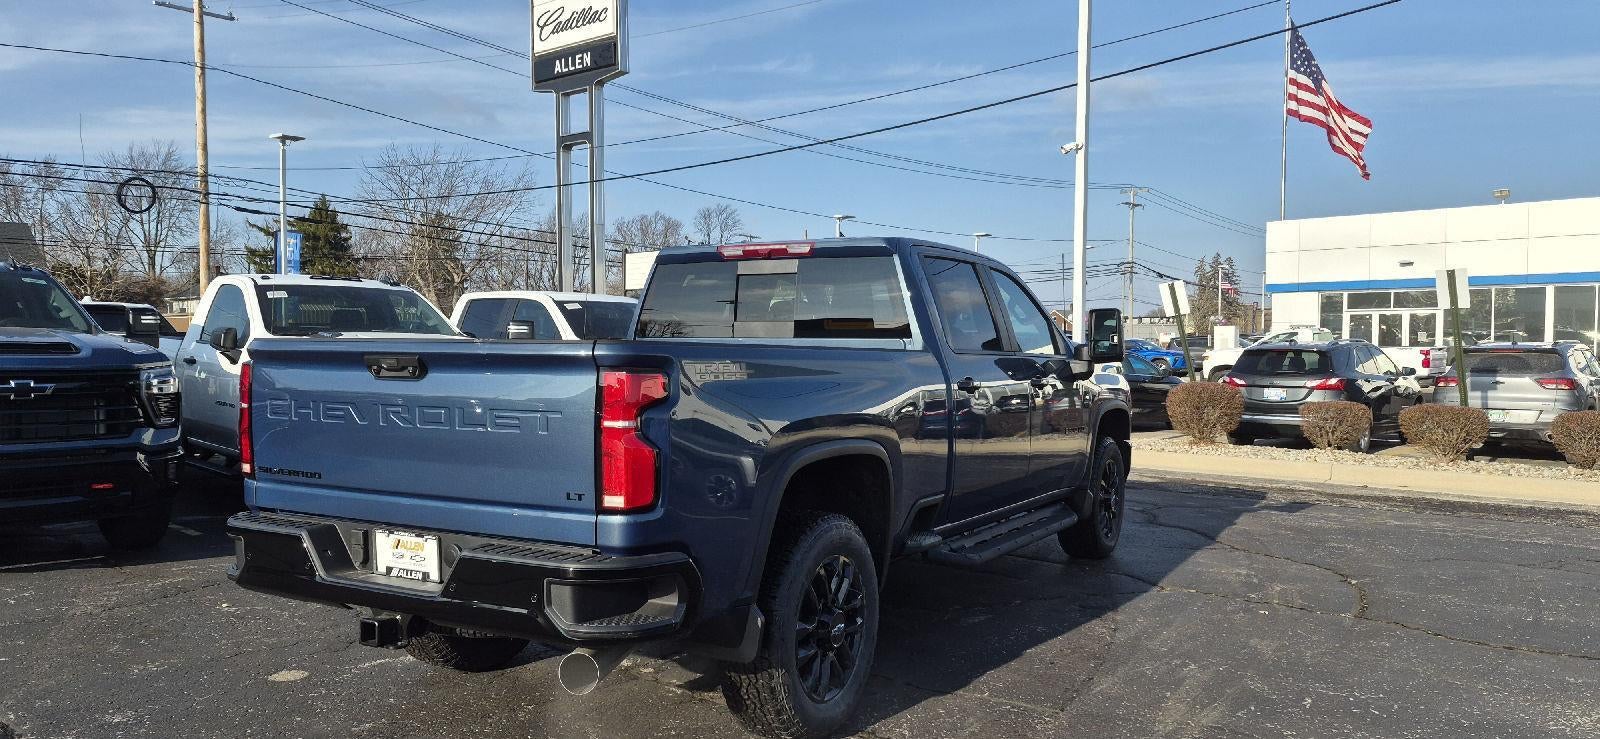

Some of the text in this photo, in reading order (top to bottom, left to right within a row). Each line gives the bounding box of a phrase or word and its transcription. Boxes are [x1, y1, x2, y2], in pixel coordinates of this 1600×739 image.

[536, 5, 609, 42] Cadillac
[554, 51, 591, 75] ALLEN
[266, 397, 563, 435] CHEVROLET
[258, 465, 322, 480] SILVERADO
[566, 491, 585, 502] LT
[399, 539, 425, 552] ALLEN
[397, 569, 423, 580] ALLEN
